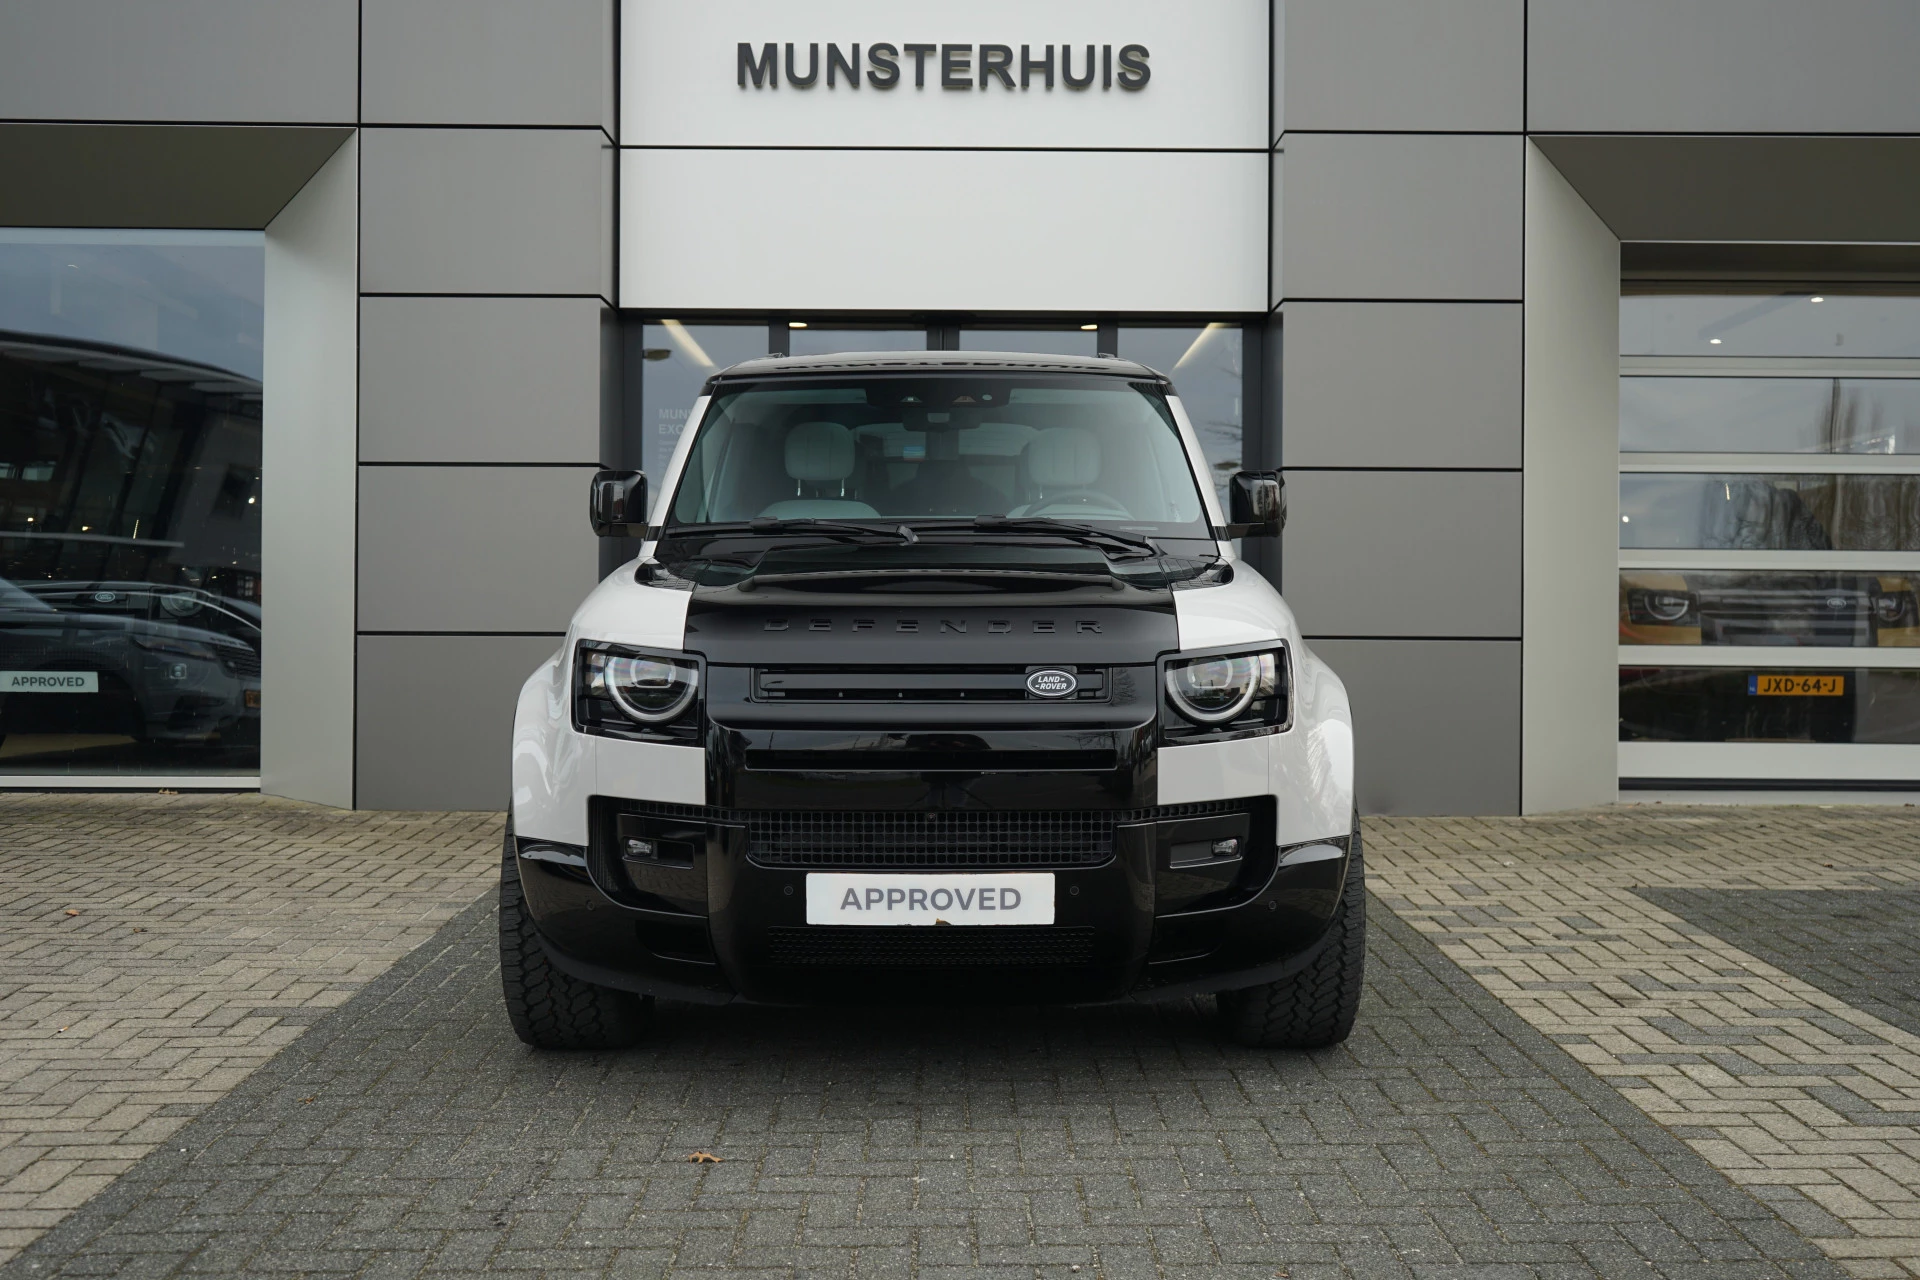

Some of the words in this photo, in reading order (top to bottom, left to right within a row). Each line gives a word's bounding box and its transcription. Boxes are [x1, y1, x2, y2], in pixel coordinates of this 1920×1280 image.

[737, 42, 1152, 90] MUNSTERHUIS
[763, 618, 1103, 634] DEFENDER
[11, 676, 85, 687] APPROVED
[1763, 678, 1836, 693] JXD-64-J
[840, 887, 1022, 911] APPROVED
